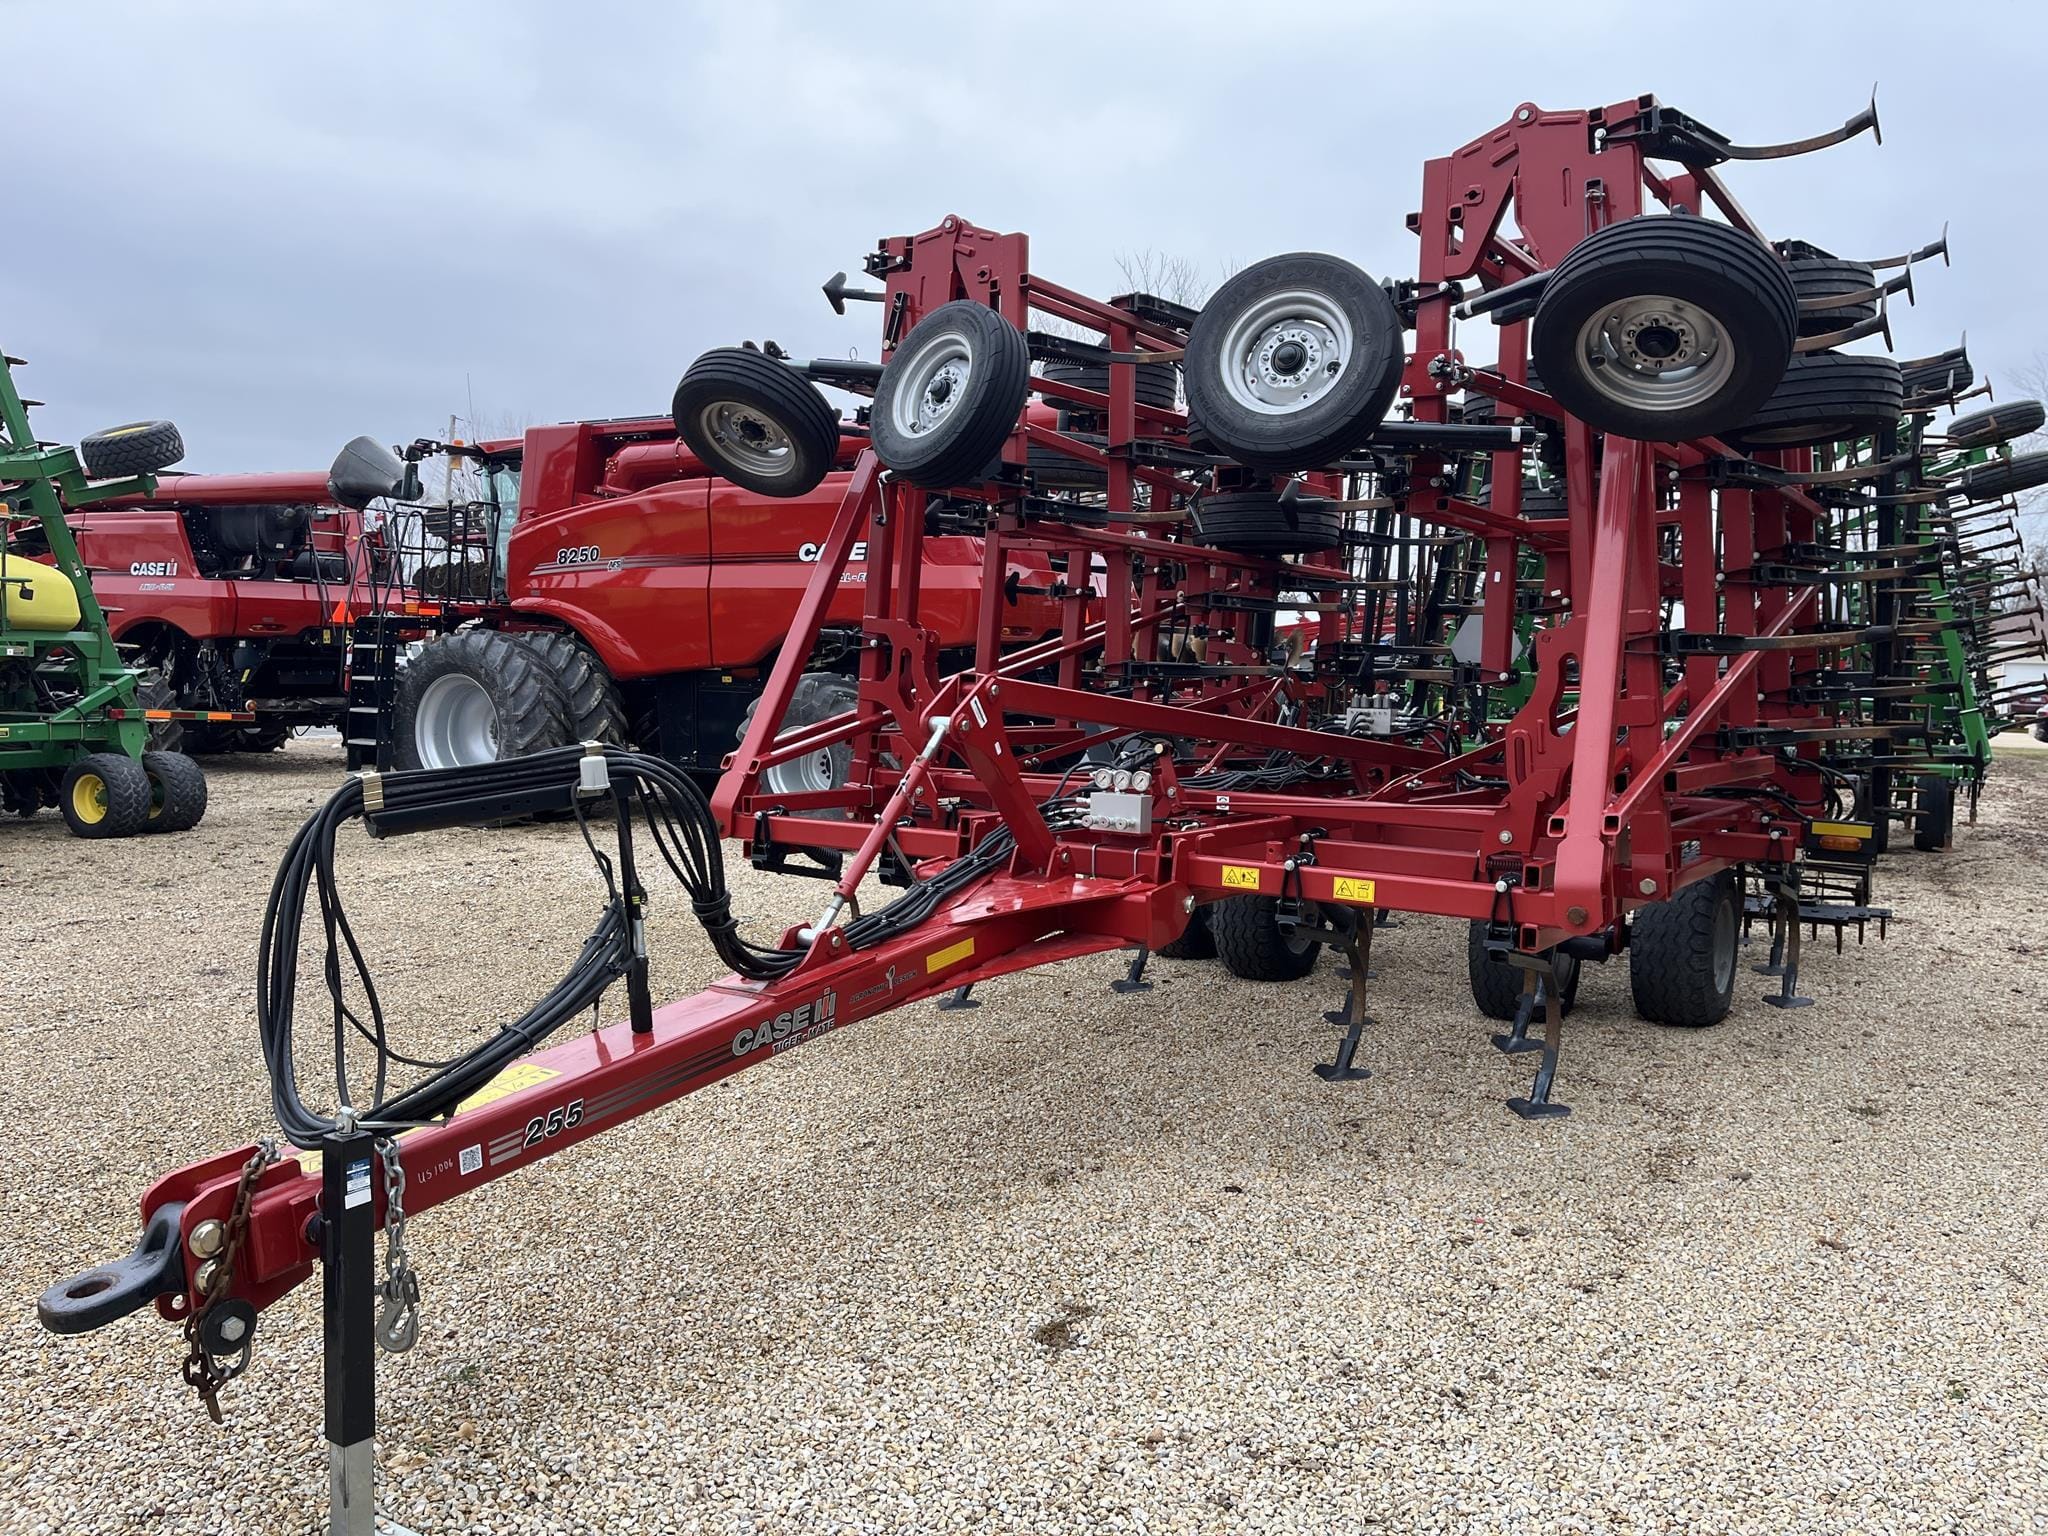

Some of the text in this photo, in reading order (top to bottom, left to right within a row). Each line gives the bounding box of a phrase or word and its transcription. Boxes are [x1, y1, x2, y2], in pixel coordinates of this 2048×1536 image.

[130, 562, 165, 576] CASE
[556, 545, 600, 565] 8250
[732, 1003, 811, 1056] CASE
[772, 1018, 836, 1054] TIGER-MATE
[522, 1097, 585, 1149] 255
